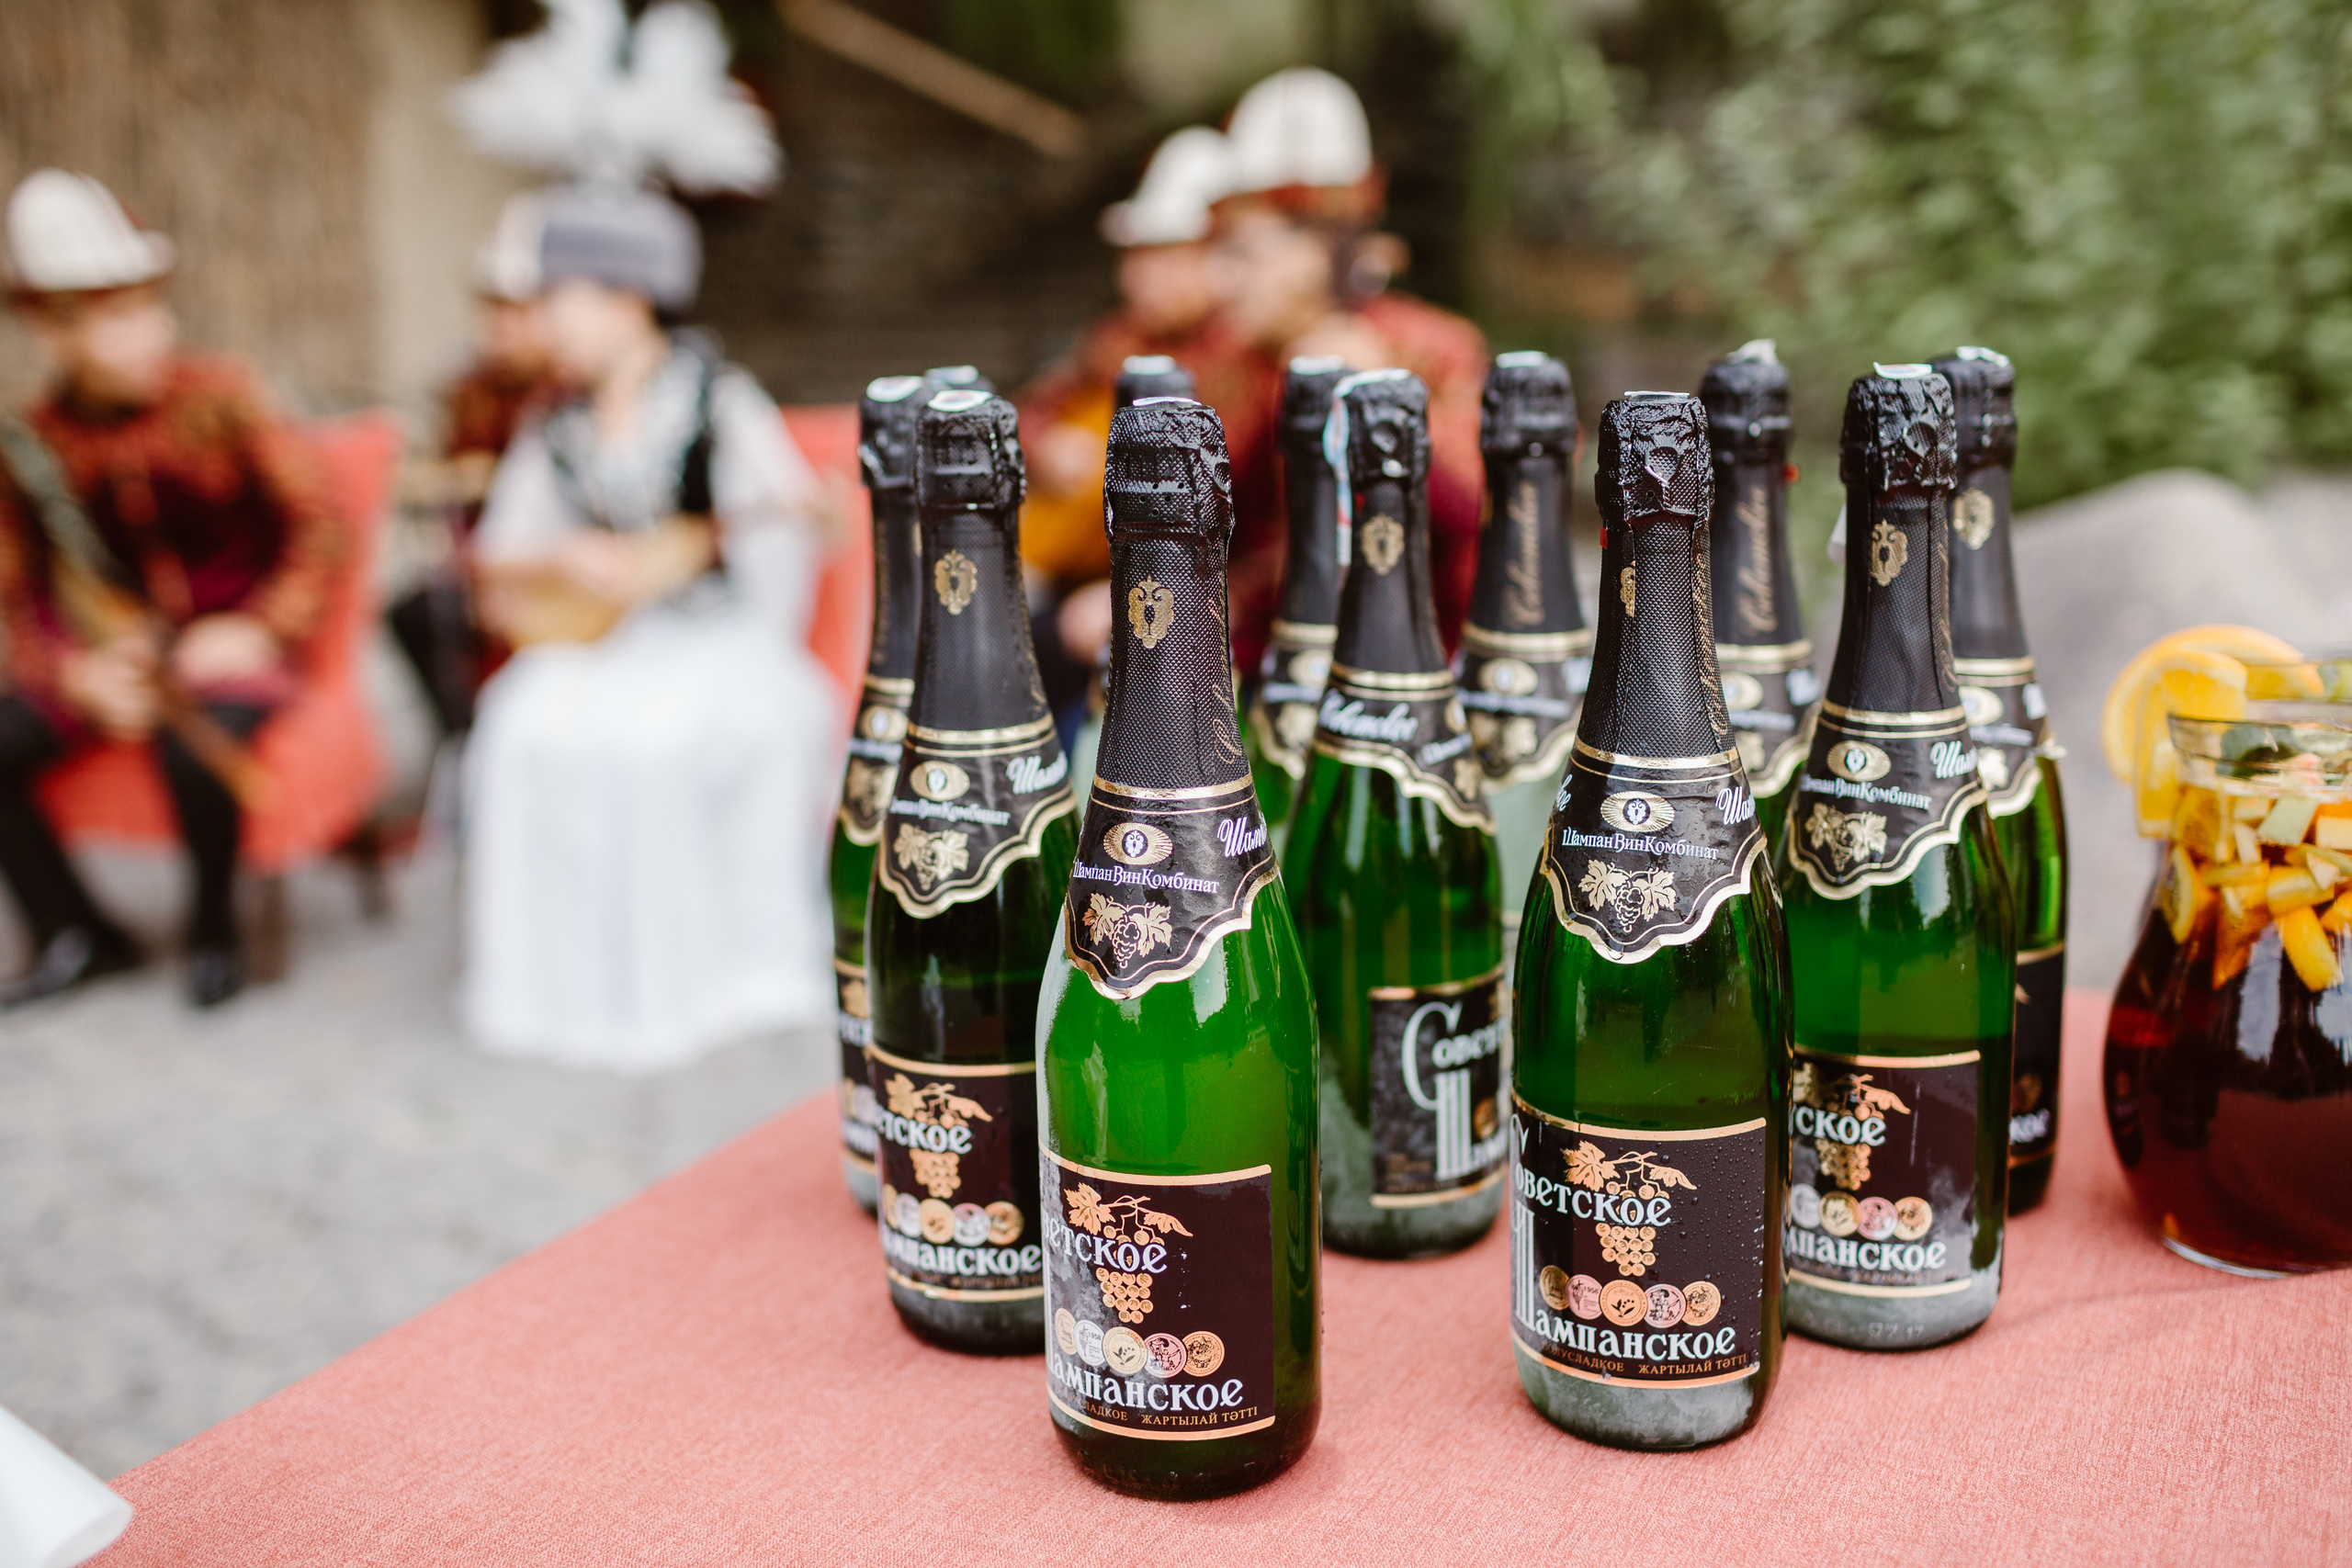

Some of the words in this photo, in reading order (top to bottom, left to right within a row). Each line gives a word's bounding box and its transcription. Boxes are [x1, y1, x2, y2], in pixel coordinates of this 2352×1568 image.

[1561, 827, 1719, 860] ШампанВинКомбинат
[1072, 859, 1220, 895] ШампанВинКомбинат
[1638, 1360, 1713, 1375] ЖАРТЫЛАЙ
[1141, 1412, 1218, 1426] ЖАРТЫЛАЙ
[1222, 1405, 1259, 1423] ТӘТТІ
